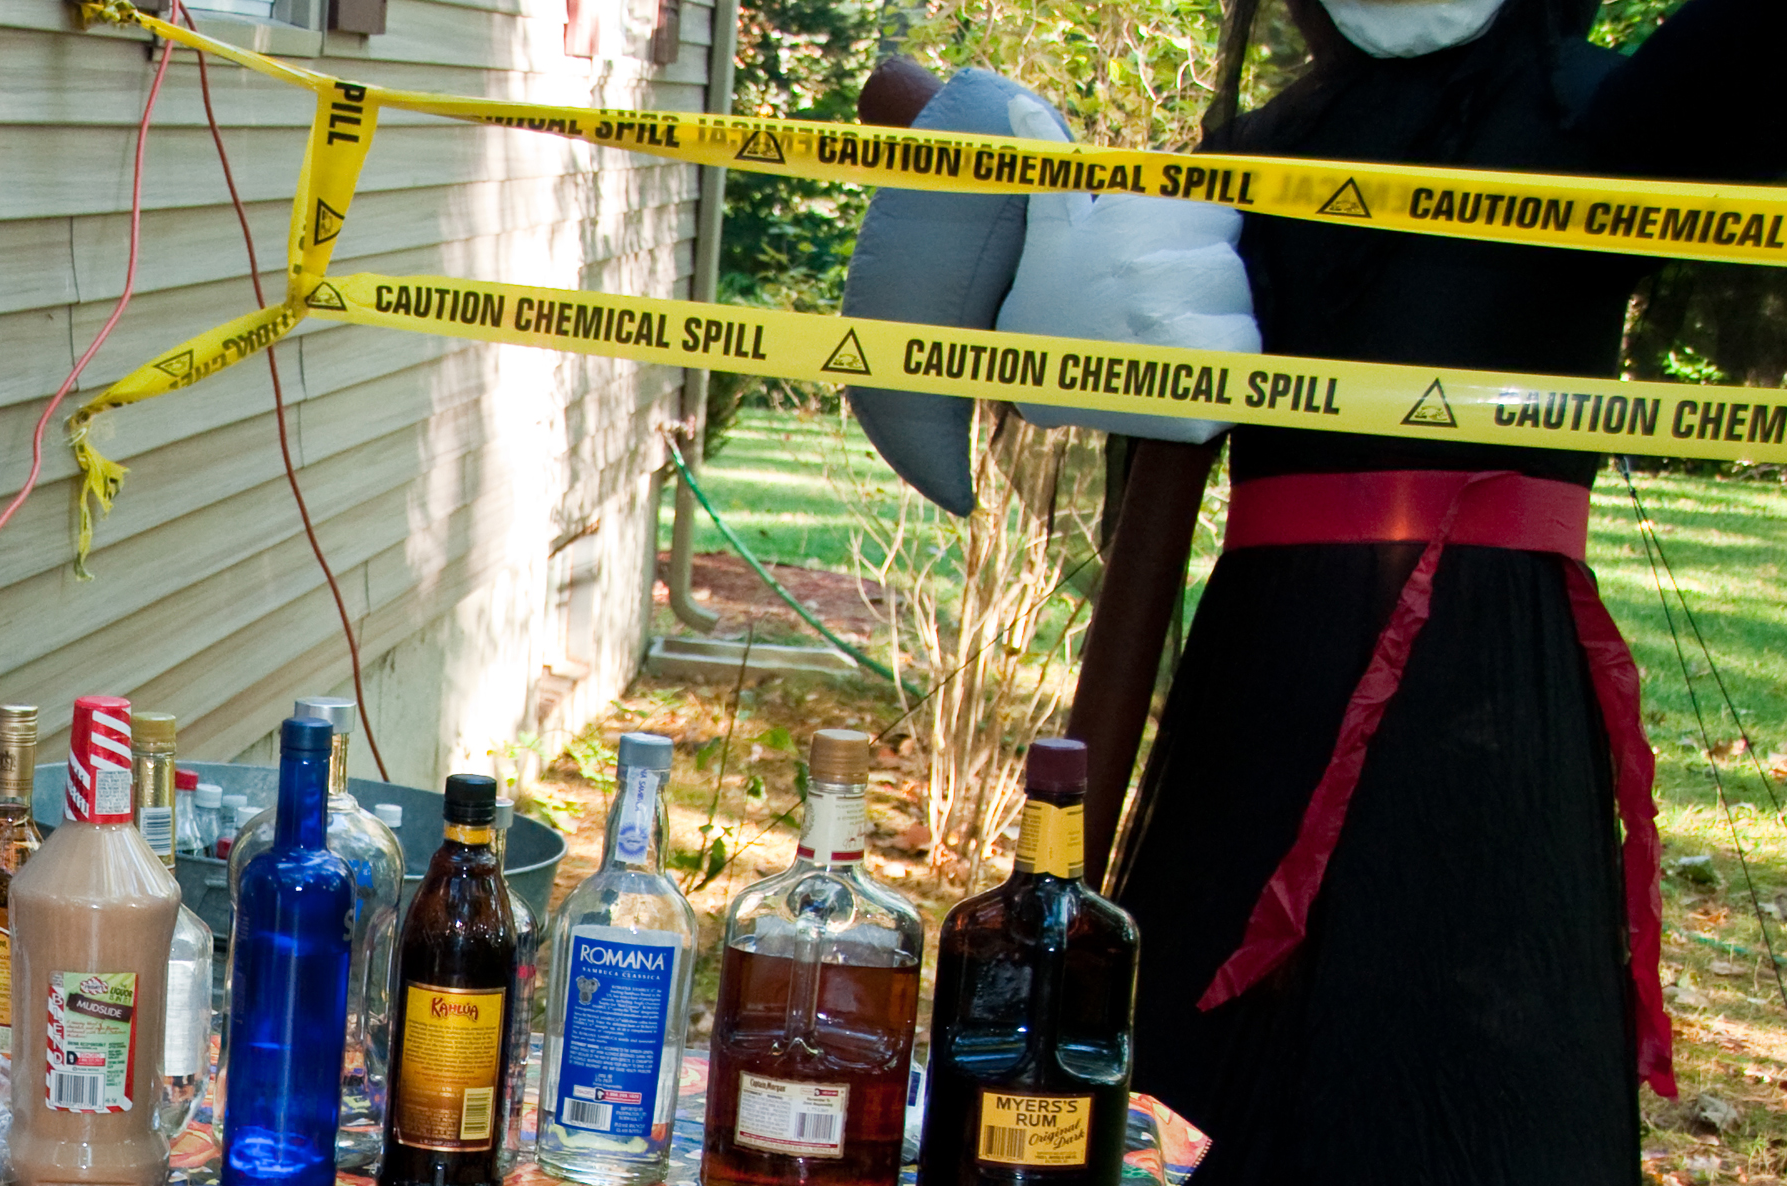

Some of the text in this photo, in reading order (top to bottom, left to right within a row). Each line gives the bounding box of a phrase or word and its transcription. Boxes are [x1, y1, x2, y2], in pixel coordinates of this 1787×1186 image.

[817, 135, 961, 178] CAUTION
[973, 149, 1147, 193] CHEMICAL
[1159, 164, 1255, 206] SPILL
[1408, 187, 1786, 250] CAUTION CHEMICAL
[375, 284, 767, 361] CAUTION CHEMICAL SPILL
[903, 339, 1340, 415] CAUTION CHEMICAL SPILL
[1494, 390, 1787, 445] CAUTION CHEM
[580, 944, 665, 971] ROMANA
[582, 966, 661, 981] SAMBUCA CLASSICA
[110, 987, 133, 998] LIQUOR
[76, 1000, 123, 1019] MUDSLIDE
[52, 992, 64, 1065] BLEND
[1015, 1112, 1058, 1128] RUM
[1028, 1118, 1082, 1146] Original
[1053, 1128, 1085, 1150] Dark
